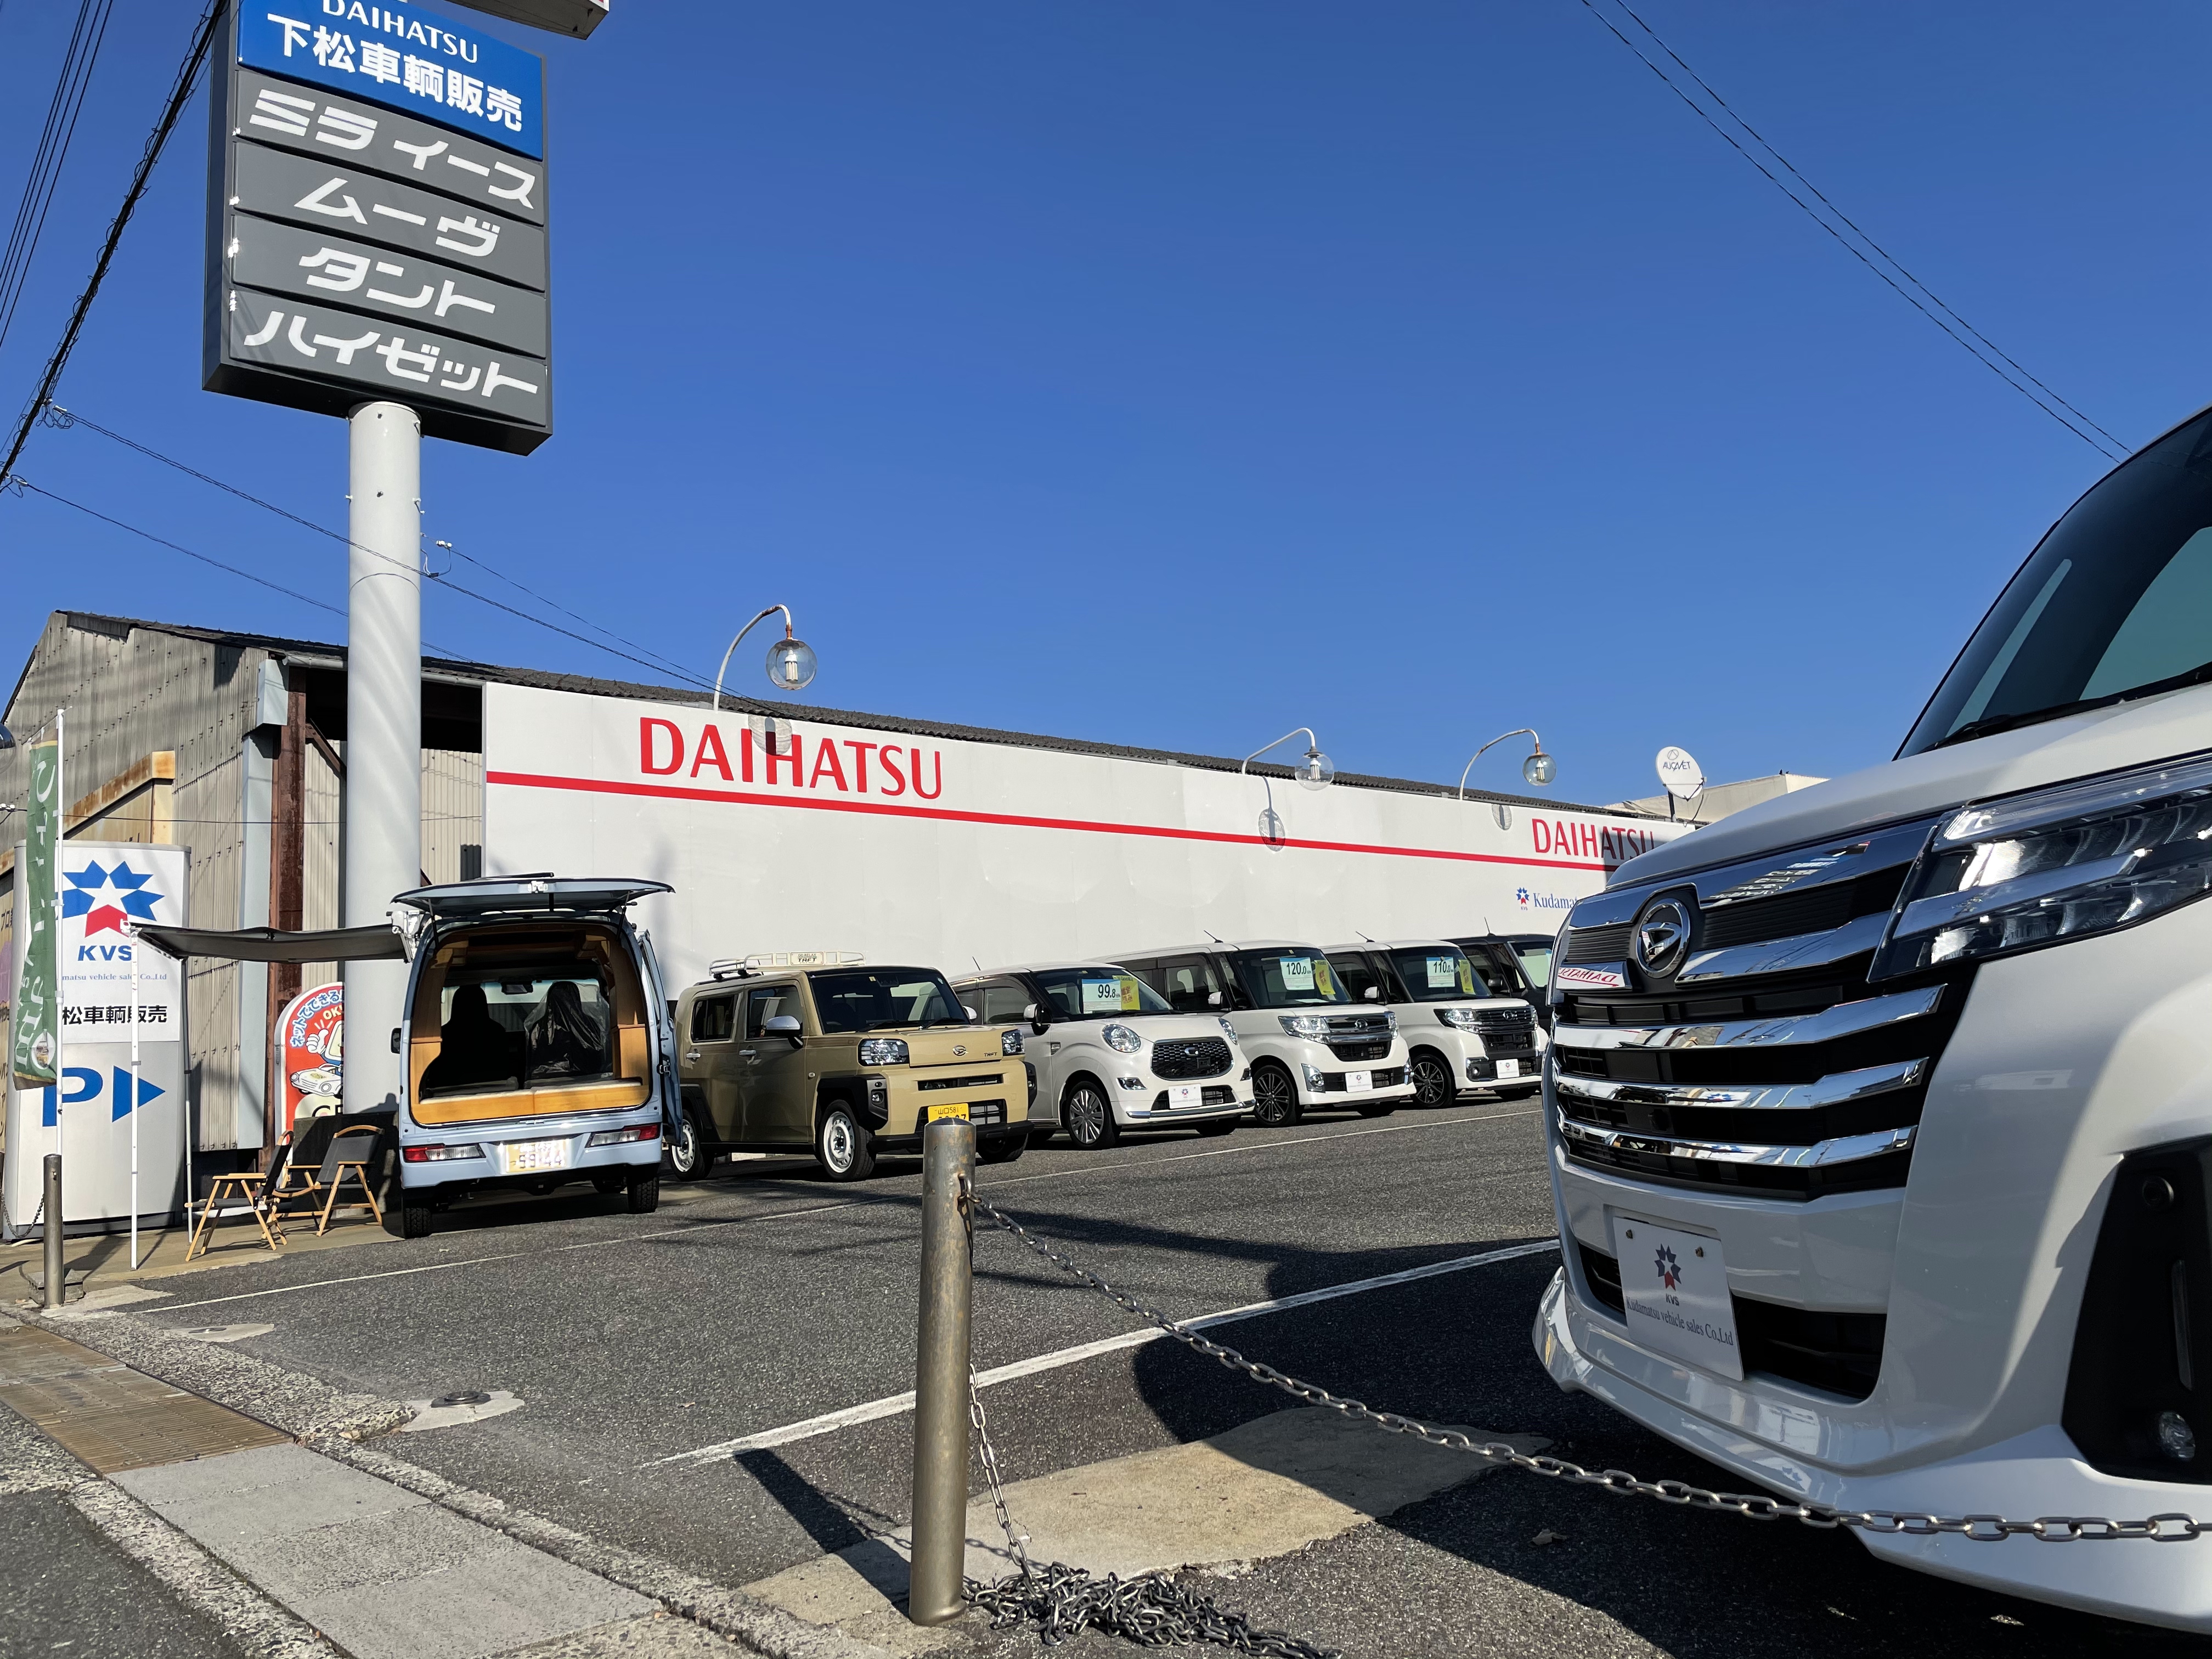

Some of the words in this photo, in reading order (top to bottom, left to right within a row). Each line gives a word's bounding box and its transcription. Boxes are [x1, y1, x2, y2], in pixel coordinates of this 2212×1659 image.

[323, 0, 477, 63] DAIHATSU
[249, 89, 378, 150] ミラ
[393, 140, 536, 210] イース
[294, 177, 500, 257] ムーヴ
[298, 247, 495, 317] タント
[244, 311, 538, 397] ハイゼット
[640, 716, 942, 800] DAIHATSU
[1663, 760, 1690, 771] AUCNET
[1532, 818, 1655, 860] DAIHATSU
[77, 945, 132, 961] KVS
[1286, 962, 1307, 975] 120.0
[1434, 961, 1451, 973] 110.0
[1098, 984, 1116, 998] 99.8
[62, 1005, 167, 1025] 松車輌販売
[42, 1067, 103, 1127] P
[1626, 1295, 1661, 1320] Kudamatsu
[1661, 1310, 1685, 1329] vehicle
[1686, 1318, 1704, 1336] sales
[1666, 1293, 1679, 1306] KVS
